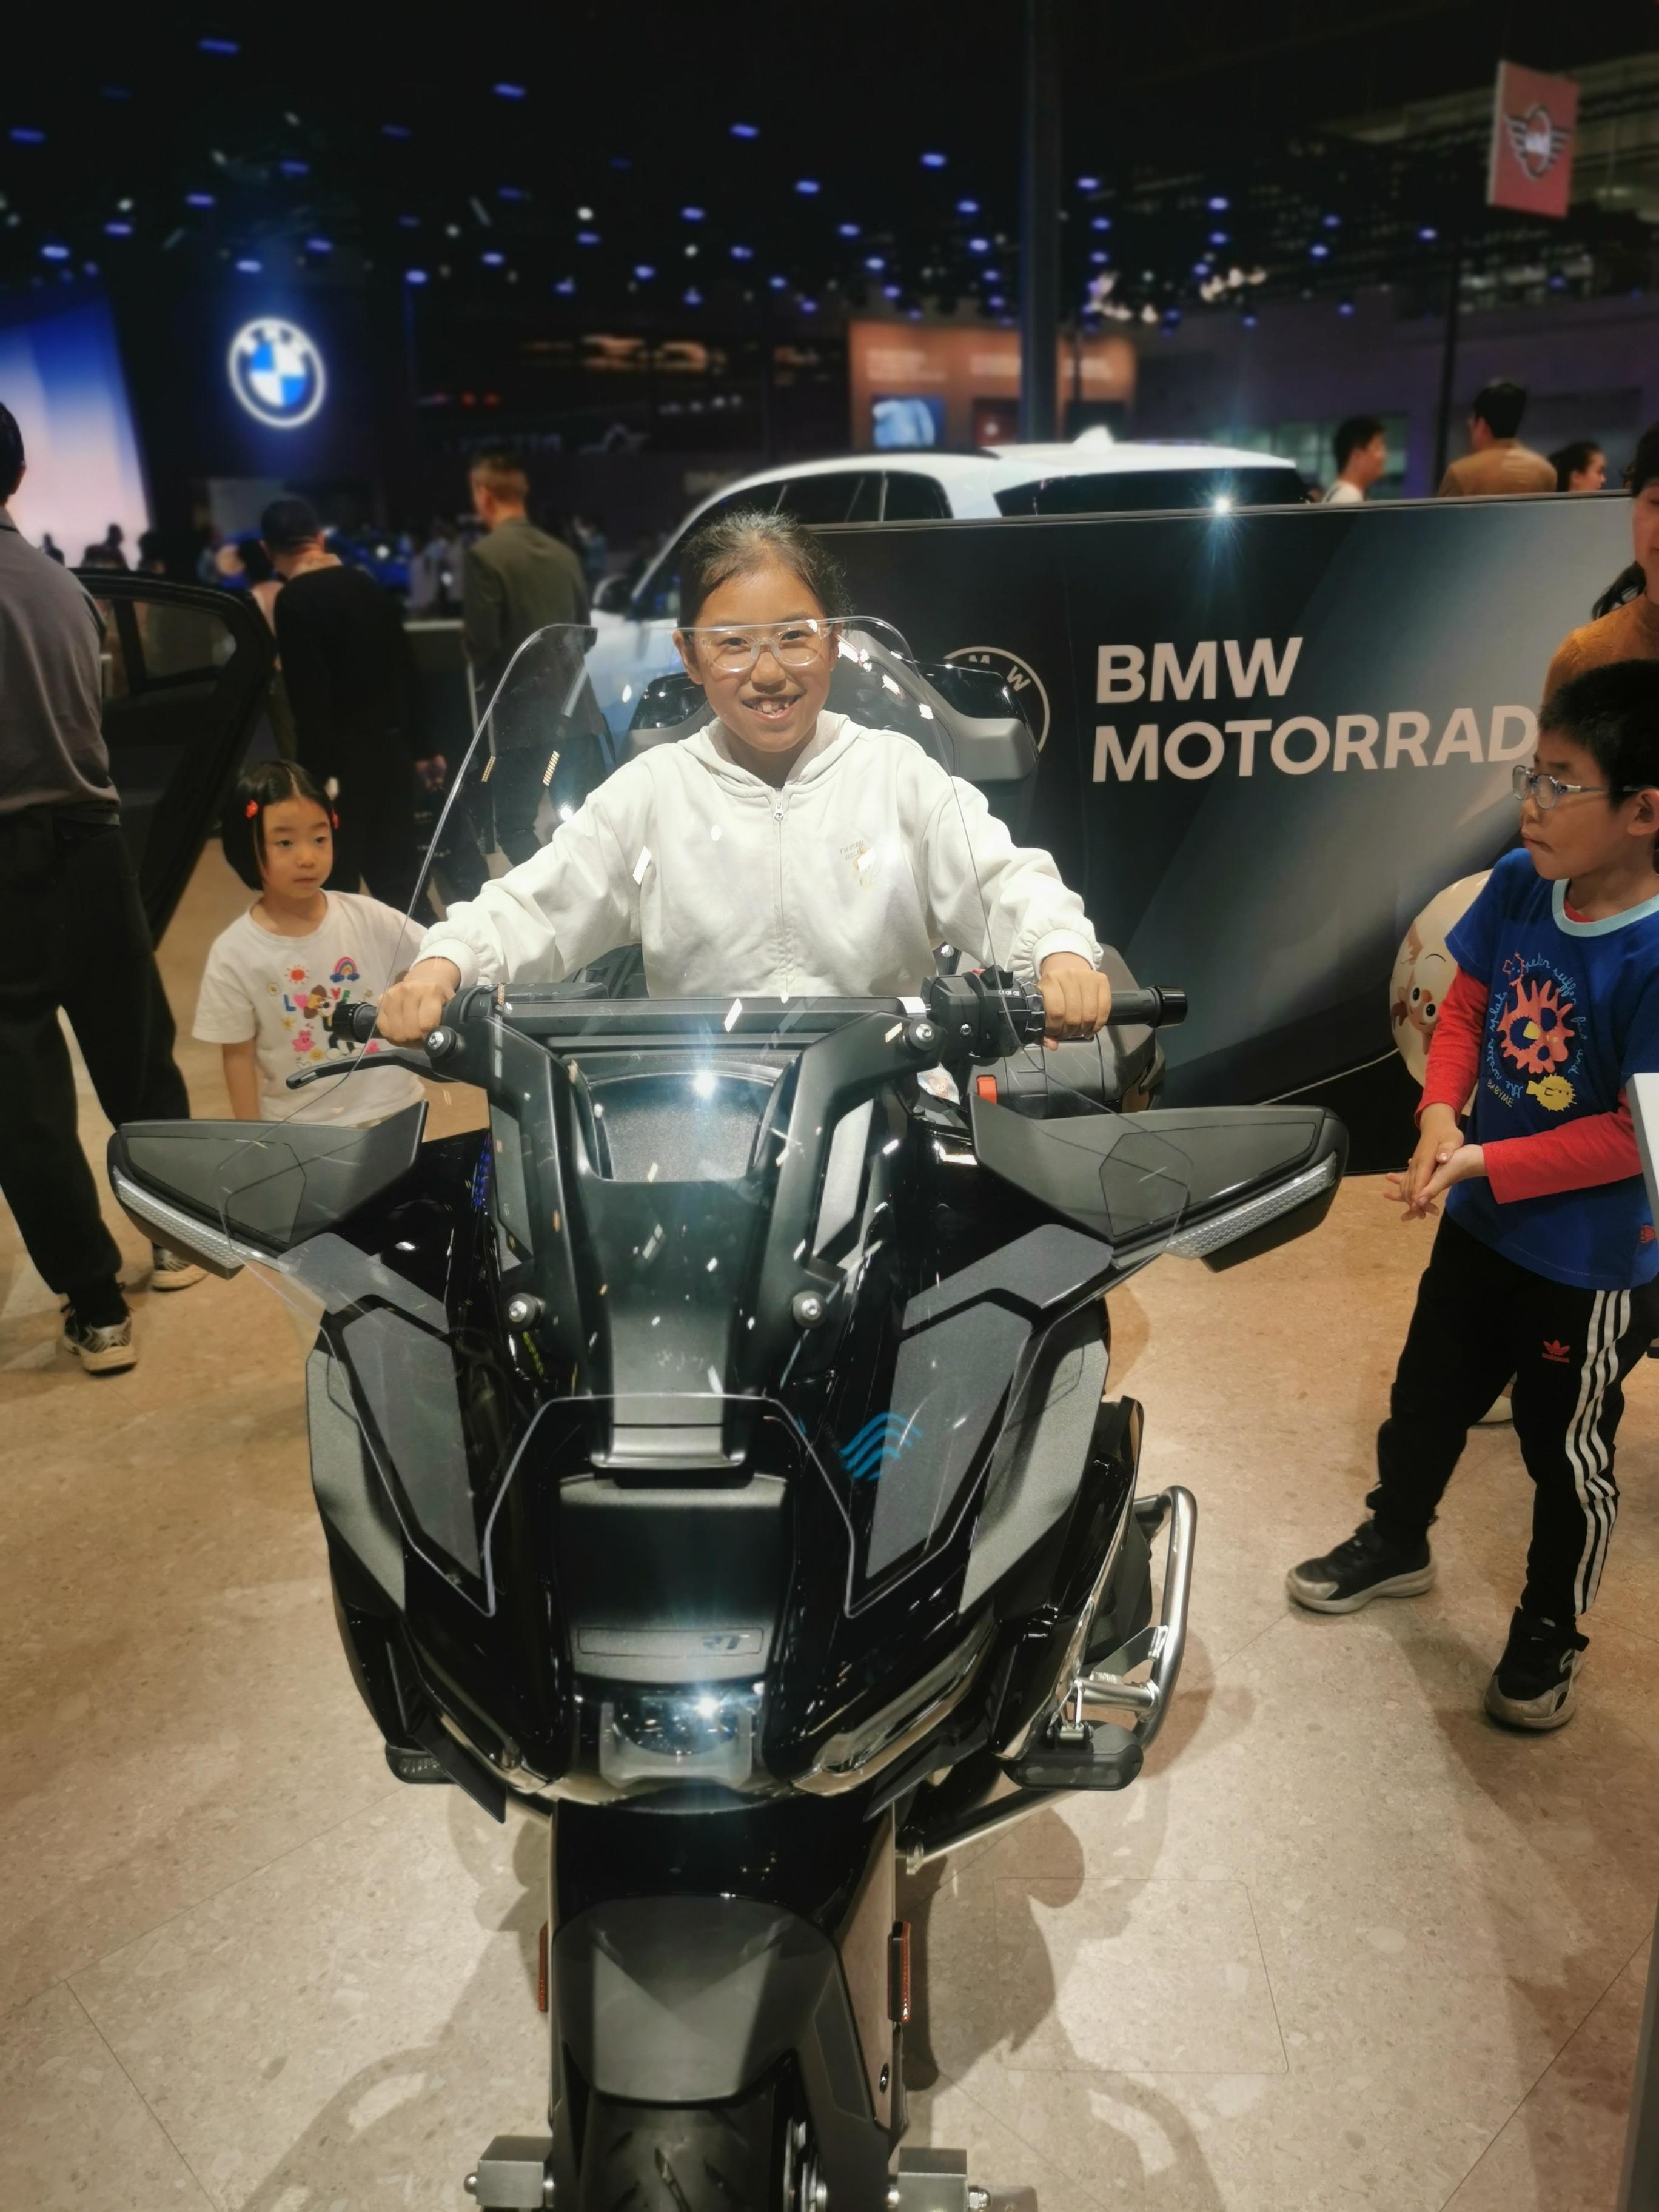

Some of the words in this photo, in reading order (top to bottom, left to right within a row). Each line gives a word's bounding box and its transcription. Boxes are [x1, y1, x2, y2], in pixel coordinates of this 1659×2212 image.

[1096, 637, 1303, 703] BMW
[1093, 705, 1538, 782] MOTORRAD
[1506, 1081, 1523, 1098] the
